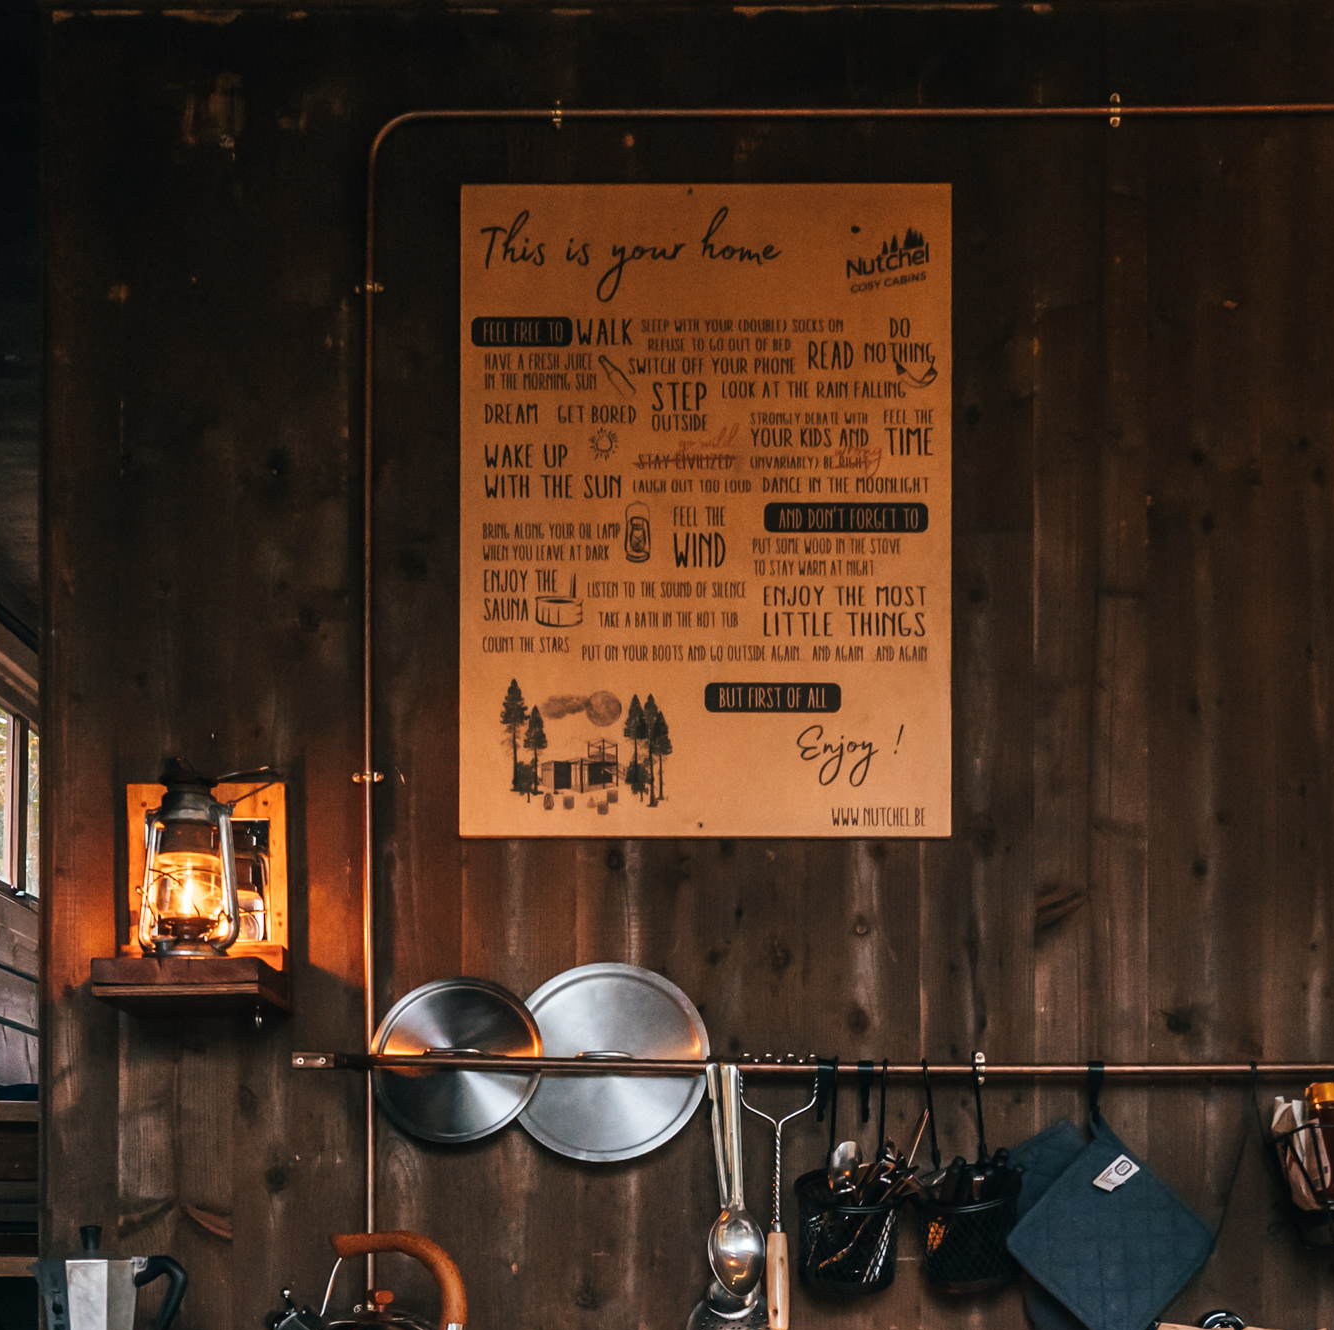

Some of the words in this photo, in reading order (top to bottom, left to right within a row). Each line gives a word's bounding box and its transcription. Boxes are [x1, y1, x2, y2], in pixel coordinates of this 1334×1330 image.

[480, 209, 545, 270] This
[566, 236, 590, 266] is
[596, 243, 685, 302] your
[702, 207, 781, 264] home
[846, 243, 930, 280] Nutchel
[884, 271, 927, 288] CABINS
[484, 322, 507, 342] FEEL
[514, 322, 538, 342] FREE
[548, 322, 563, 342] TO
[577, 319, 632, 345] WALK
[641, 319, 669, 333] SLEEP
[674, 319, 699, 332] WITH
[705, 319, 733, 332] YOUR
[792, 319, 824, 332] SOCKS
[828, 319, 843, 332] ON
[890, 318, 910, 338] DO
[692, 338, 704, 351] TO
[709, 338, 724, 351] GO
[728, 338, 749, 351] OUT
[755, 338, 768, 352] OF
[773, 338, 791, 351] BED
[864, 343, 935, 363] NOTHING
[485, 353, 511, 370] HAVE
[518, 354, 524, 370] A
[529, 353, 559, 370] FRESH
[565, 353, 592, 370] JUICE
[808, 341, 853, 369] READ
[629, 357, 675, 374] SWITCH
[682, 358, 703, 374] OFF
[712, 358, 747, 374] YOUR
[754, 358, 795, 374] PHONE
[485, 373, 495, 389] IN
[501, 373, 517, 390] THE
[523, 373, 570, 390] MORNING
[576, 373, 596, 390] SUN
[722, 381, 755, 398] LOOK
[762, 381, 779, 398] AT
[787, 381, 808, 398] THE
[817, 381, 848, 398] RAIN
[854, 381, 906, 398] FALLING
[652, 382, 707, 412] STEP
[485, 404, 538, 424] DREAM
[558, 405, 584, 423] GET
[592, 405, 636, 424] BORED
[652, 414, 706, 431] OUTSIDE
[750, 412, 800, 425] STRONGLY
[803, 412, 838, 425] DEBATE
[844, 413, 867, 424] WITH
[884, 410, 909, 424] FEEL
[917, 409, 933, 424] THE
[751, 428, 792, 447] YOUR
[801, 428, 831, 447] KIDS
[840, 428, 868, 449] AND
[884, 428, 933, 456] TIME
[485, 444, 533, 468] WAKE
[544, 444, 567, 468] UP
[823, 456, 834, 470] BE
[485, 475, 529, 498] WITH
[541, 475, 572, 498] THE
[584, 475, 621, 498] SUN
[633, 480, 666, 493] LAUGH
[671, 479, 692, 493] OUT
[700, 479, 720, 493] TOO
[725, 480, 751, 493] LOUD
[763, 477, 799, 493] DANCE
[809, 477, 821, 493] IN
[828, 477, 848, 493] THE
[856, 475, 928, 493] MOONLIGHT
[673, 506, 697, 527] FEEL
[705, 506, 725, 526] THE
[779, 509, 802, 528] AND
[808, 507, 843, 528] DON'T
[851, 508, 896, 529] FORGET
[904, 509, 918, 528] TO
[483, 523, 509, 539] BRING
[514, 523, 544, 539] ALONG
[549, 523, 574, 539] YOUR
[579, 523, 591, 539] OIL
[597, 523, 620, 539] LAMP
[483, 545, 508, 560] WHEN
[512, 545, 532, 561] YOU
[536, 545, 564, 560] LEAVE
[570, 545, 581, 560] AT
[586, 545, 609, 560] DARK
[674, 532, 725, 568] WIND
[753, 538, 771, 554] PUT
[776, 538, 798, 554] SOME
[804, 538, 831, 554] WOOD
[836, 538, 845, 554] IN
[850, 538, 865, 554] THE
[870, 538, 900, 554] STOVE
[754, 559, 765, 576] TO
[770, 560, 794, 576] STAY
[798, 560, 826, 576] WARM
[831, 560, 842, 575] AT
[846, 560, 873, 576] NIGHT
[484, 569, 527, 592] ENJOY
[535, 570, 557, 592] THE
[588, 581, 618, 598] LISTEN
[623, 582, 635, 598] TO
[641, 582, 655, 598] THE
[661, 582, 692, 598] SOUND
[696, 582, 706, 598] OF
[712, 582, 745, 598] SILENCE
[764, 586, 824, 606] ENJOY
[837, 586, 864, 606] THE
[876, 586, 926, 606] MOST
[484, 598, 528, 621] SAUNA
[599, 612, 619, 627] TAKE
[625, 612, 630, 627] A
[635, 612, 658, 627] BATH
[663, 612, 672, 627] IN
[676, 611, 692, 627] THE
[697, 611, 715, 628] HOT
[722, 612, 738, 627] TUB
[764, 612, 832, 636] LITTLE
[846, 612, 925, 637] THINGS
[483, 636, 513, 653] COUNT
[519, 637, 534, 652] THE
[540, 637, 569, 653] STARS
[582, 645, 600, 661] PUT
[605, 645, 618, 661] ON
[622, 645, 648, 661] YOUR
[653, 645, 683, 661] BOOTS
[688, 645, 706, 661] AND
[710, 645, 723, 661] GO
[728, 645, 765, 661] OUTSIDE
[720, 688, 741, 707] BUT
[749, 688, 780, 708] FIRST
[787, 688, 800, 708] OF
[808, 688, 826, 708] ALL
[796, 724, 878, 787] Enjoy
[893, 724, 904, 755] !
